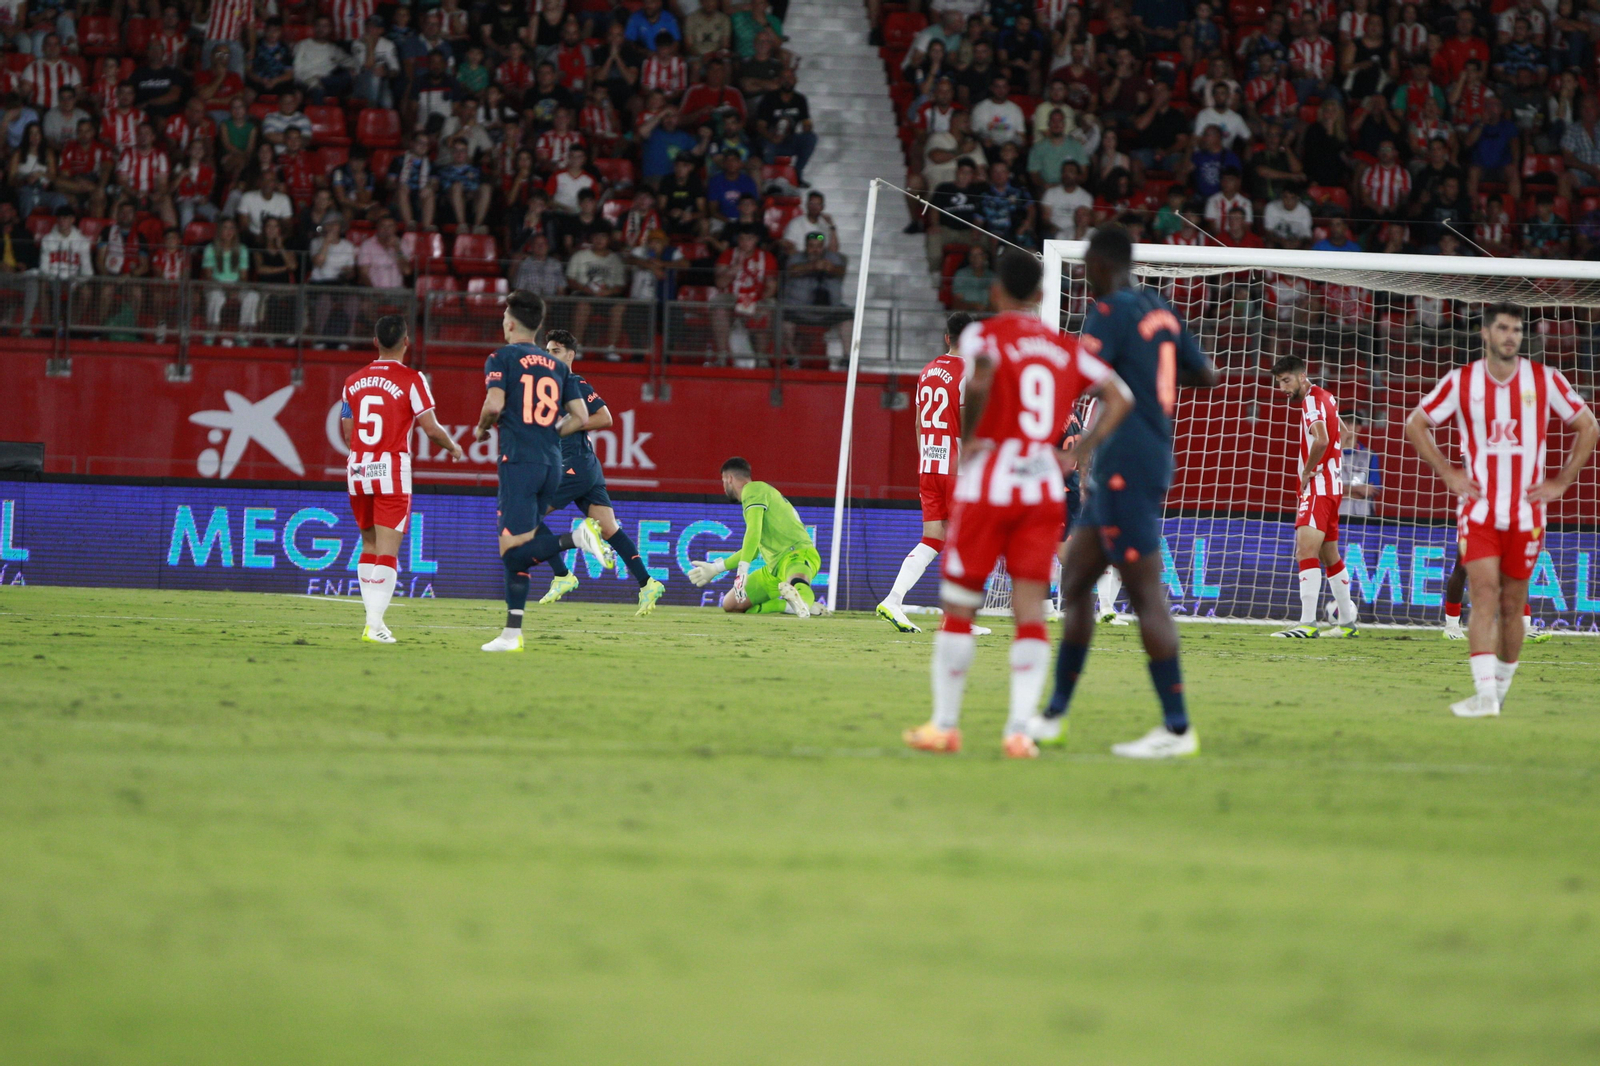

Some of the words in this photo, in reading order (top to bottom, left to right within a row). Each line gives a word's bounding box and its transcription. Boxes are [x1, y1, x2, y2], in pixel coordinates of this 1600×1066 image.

[519, 354, 556, 370] PEPELU
[927, 367, 953, 384] MONTES
[348, 376, 404, 400] ROBERTONE
[519, 373, 559, 427] 18
[920, 385, 949, 429] 22
[1018, 363, 1055, 441] 9
[358, 395, 384, 446] 5
[365, 470, 387, 478] HORSE
[366, 463, 387, 471] POWER
[167, 505, 438, 574] MEGL
[1344, 542, 1600, 612] MEAL
